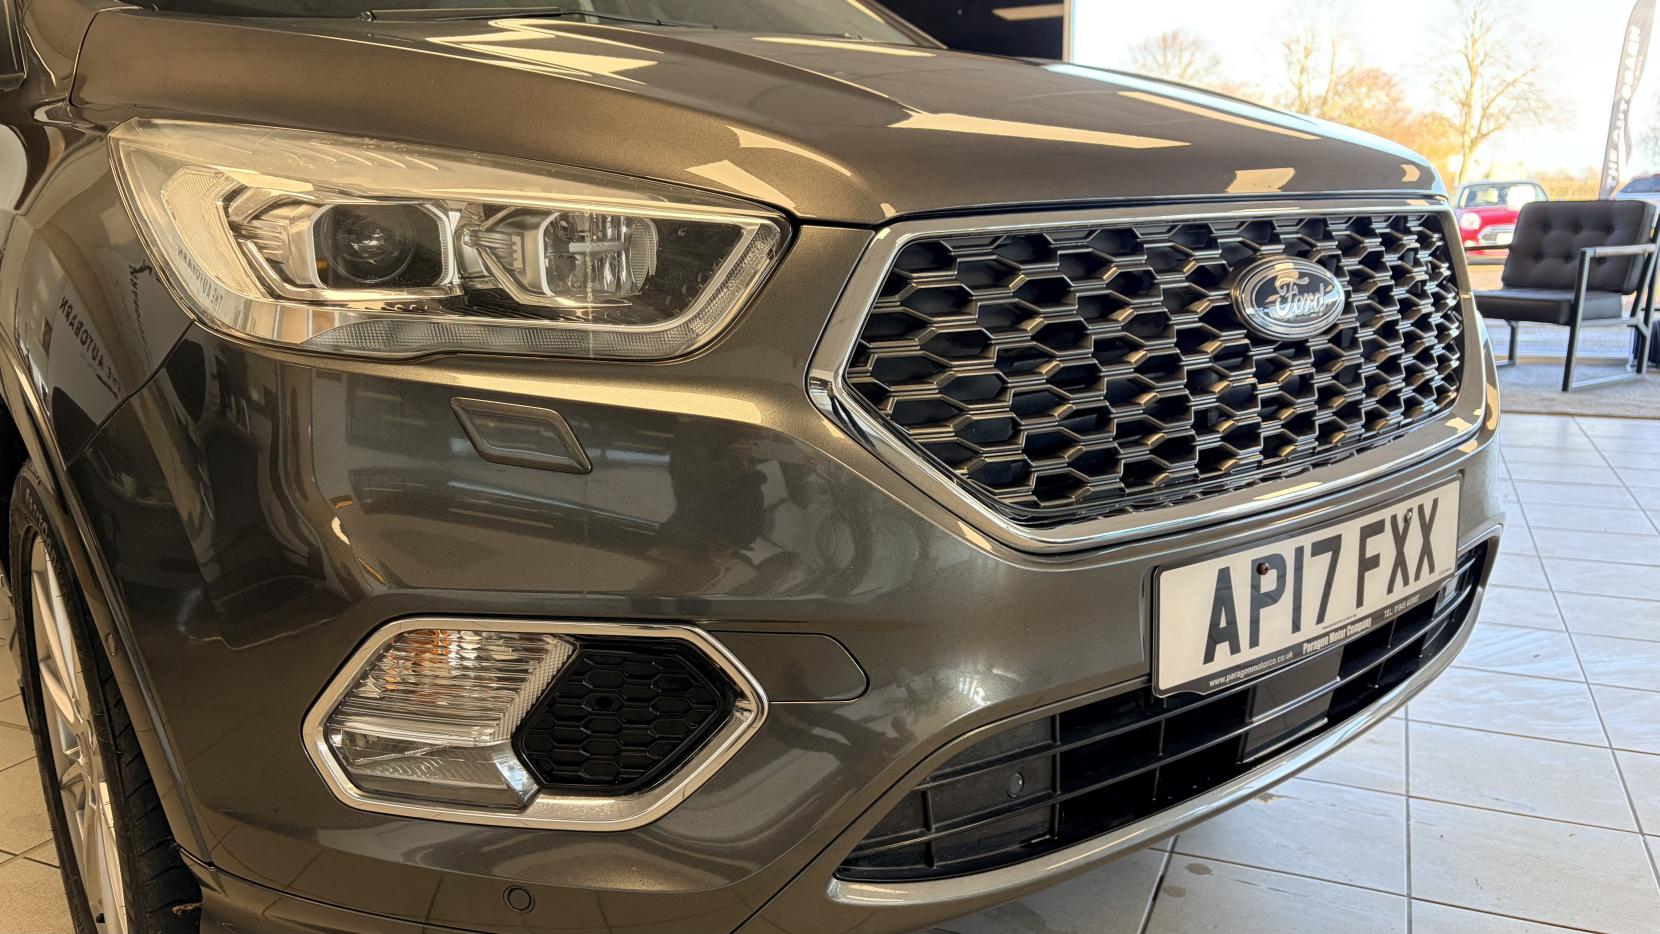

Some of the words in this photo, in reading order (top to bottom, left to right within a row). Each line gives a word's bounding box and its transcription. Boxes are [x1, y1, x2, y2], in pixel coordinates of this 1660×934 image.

[1265, 276, 1331, 318] Ford
[1202, 533, 1342, 665] AP17
[1356, 498, 1439, 609] FXX
[1209, 651, 1293, 687] www.paragonmotorco.co.uk
[1303, 636, 1329, 655] Paragon
[1330, 628, 1346, 644] Motor
[1348, 618, 1372, 636] Company
